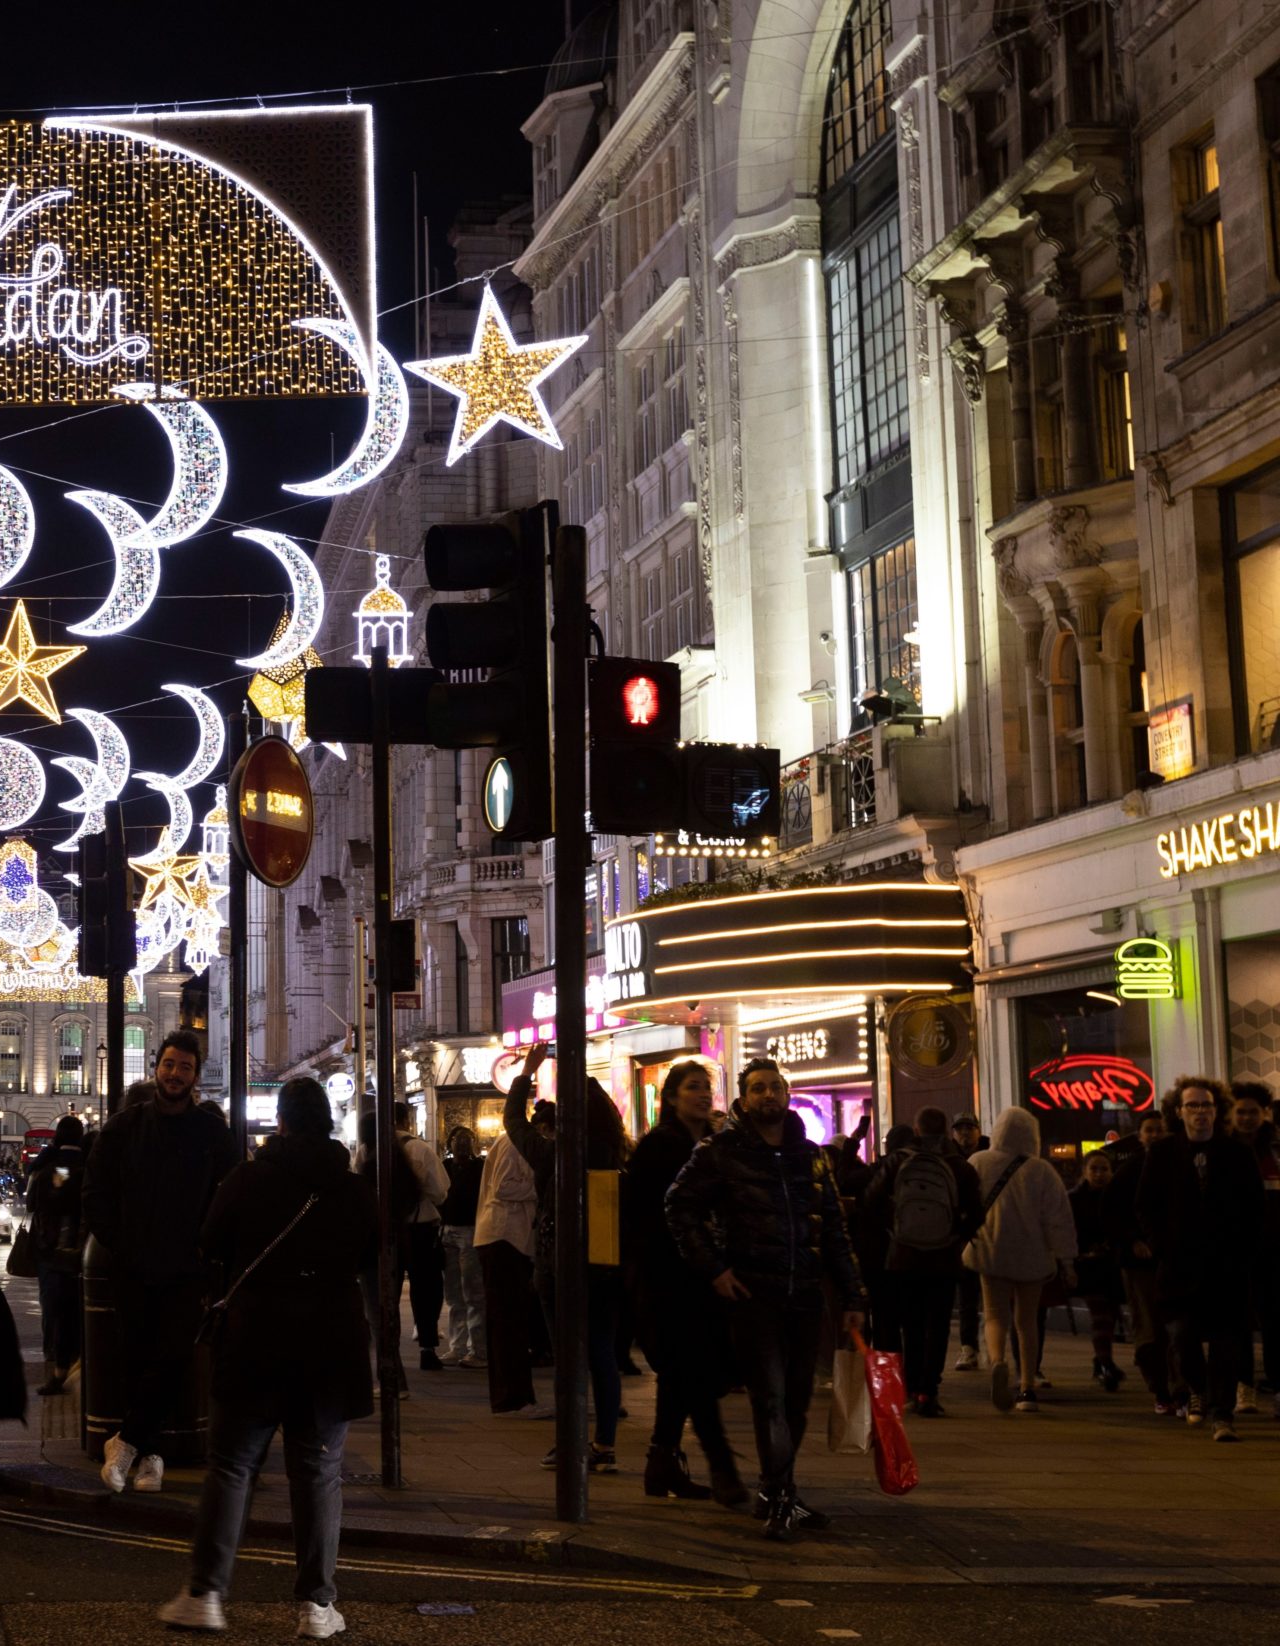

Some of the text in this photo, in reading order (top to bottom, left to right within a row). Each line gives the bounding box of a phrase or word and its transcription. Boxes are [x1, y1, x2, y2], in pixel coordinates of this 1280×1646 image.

[1153, 725, 1183, 746] COVENTRY
[1154, 742, 1176, 761] STREET
[1156, 800, 1280, 879] SHAKE SH
[766, 1028, 828, 1063] CASINO
